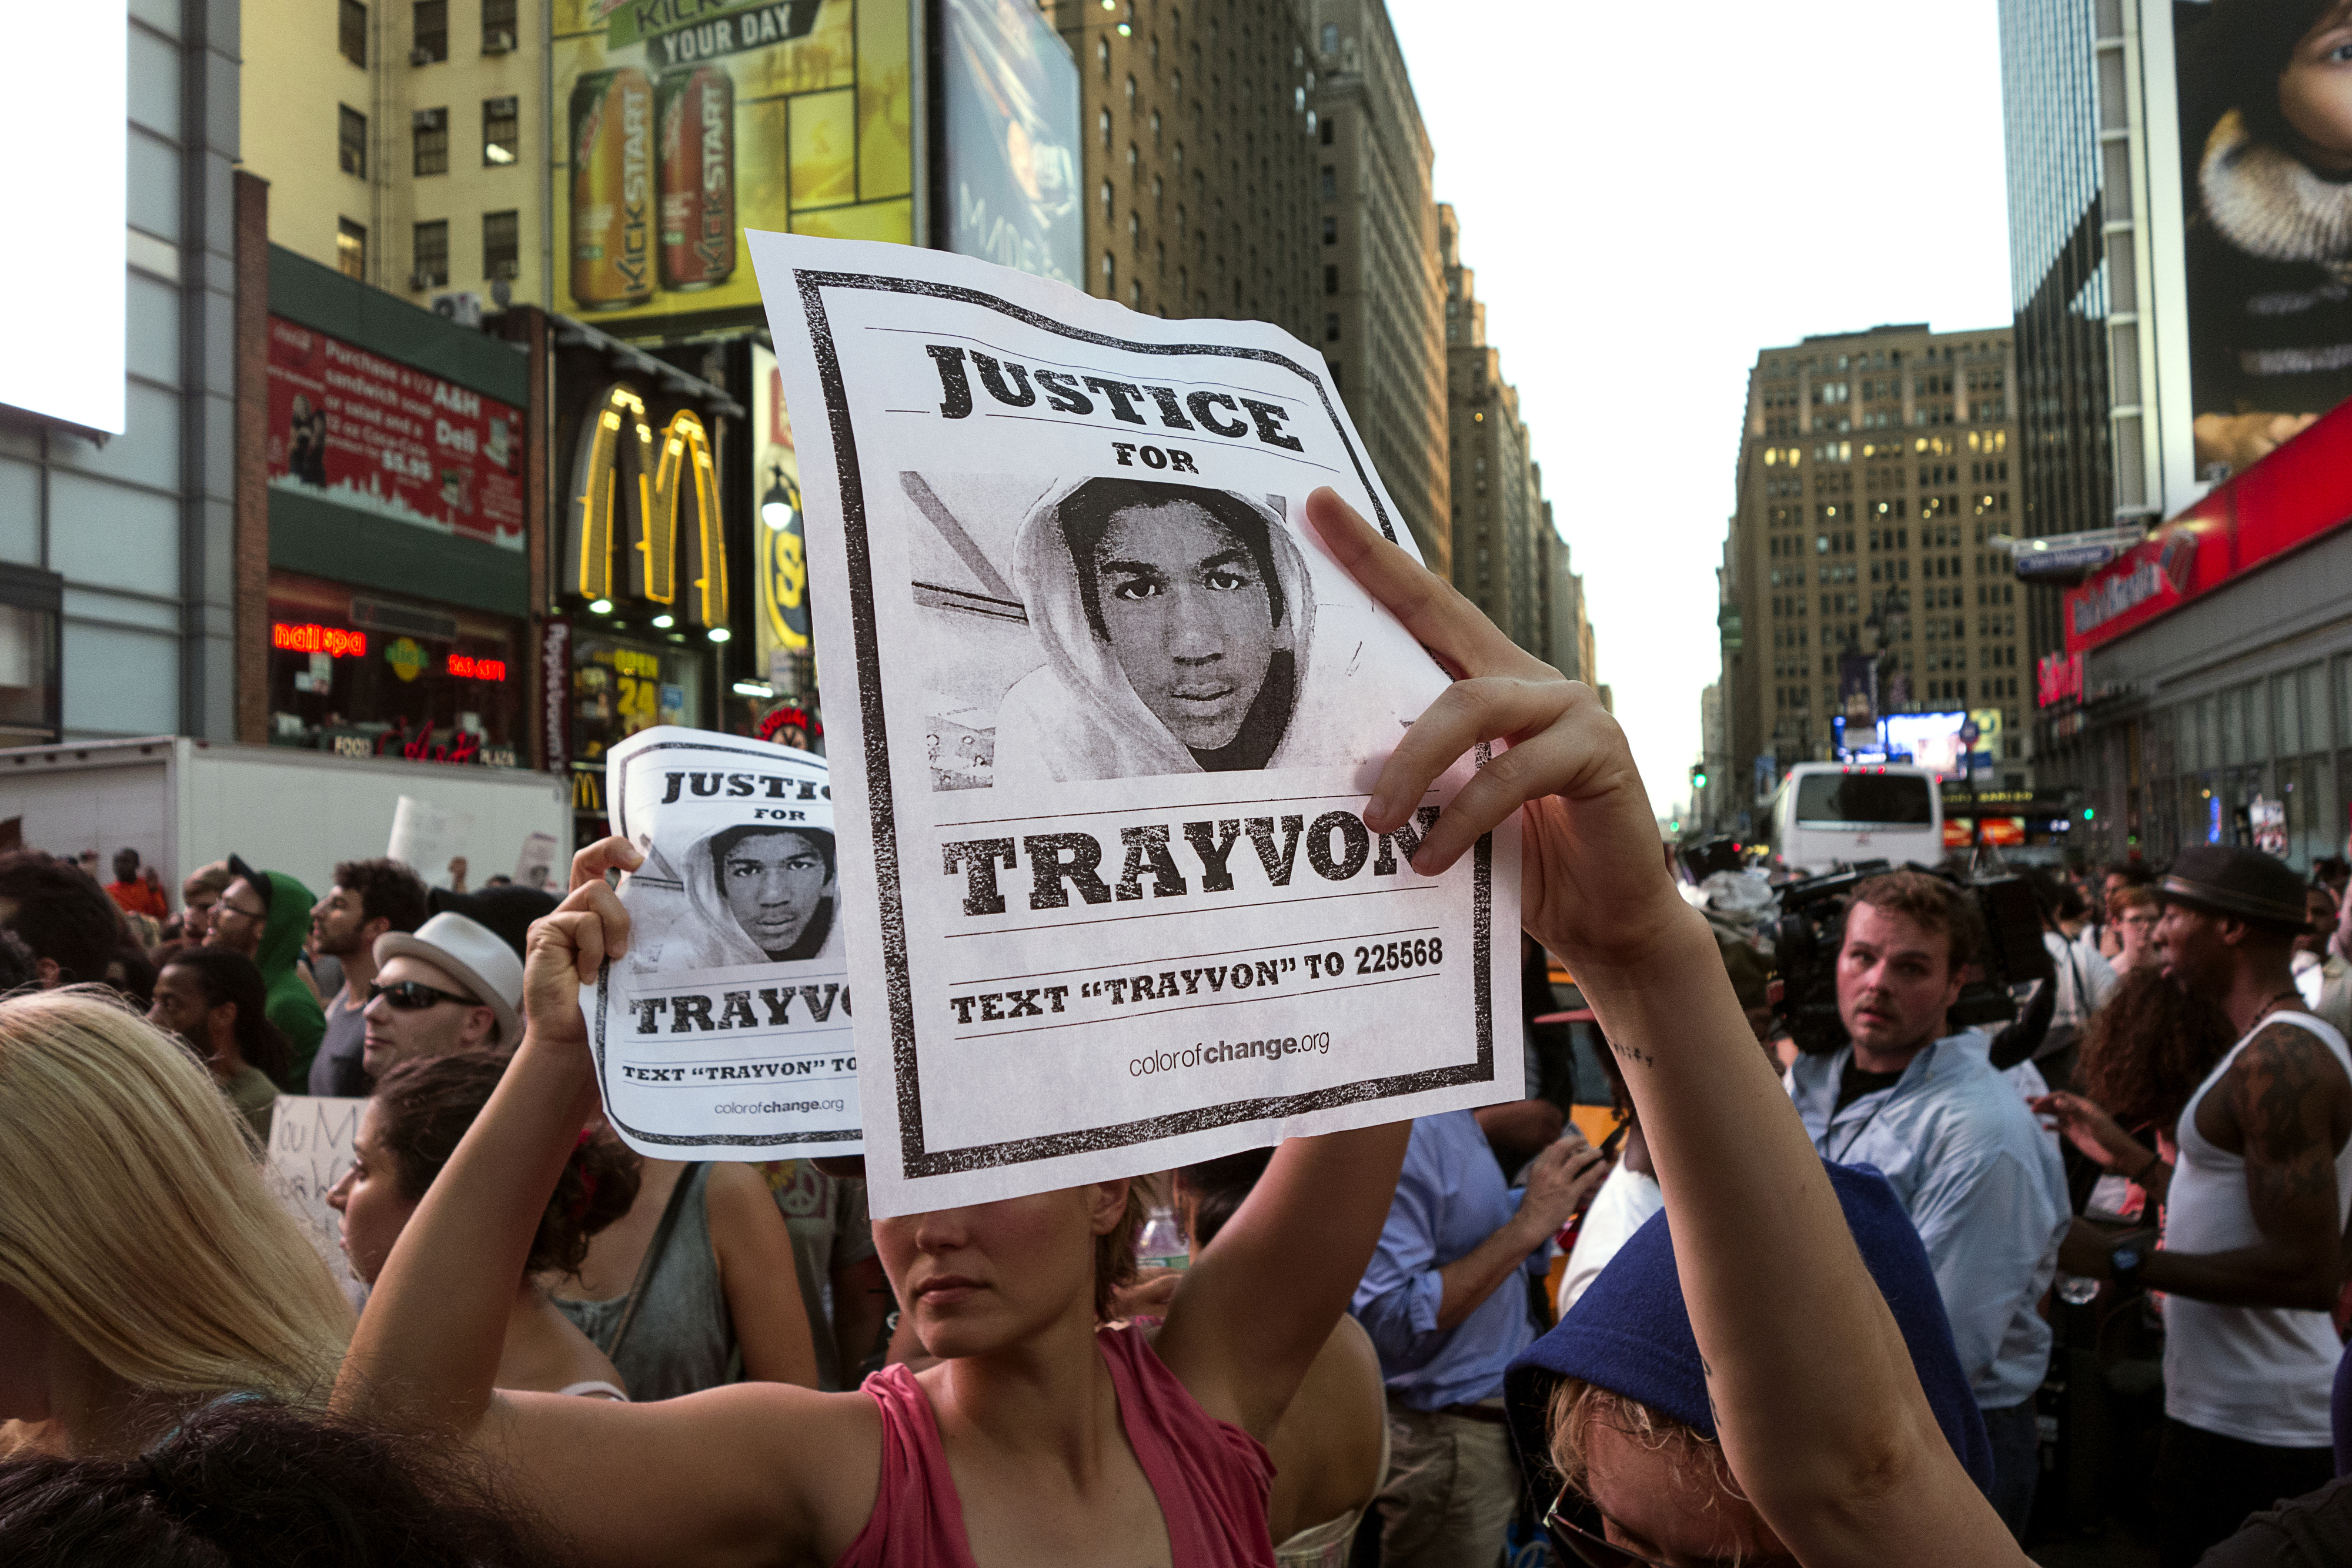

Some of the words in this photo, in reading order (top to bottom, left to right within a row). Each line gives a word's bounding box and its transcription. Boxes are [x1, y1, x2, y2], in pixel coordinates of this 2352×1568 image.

[662, 19, 734, 64] YOUR
[741, 3, 793, 46] DAY
[616, 86, 647, 295] KICKSTART
[693, 83, 726, 277] KICKSTART
[325, 368, 398, 405] sandwich
[433, 382, 480, 420] A&H
[926, 345, 1305, 453] JUSTICE
[435, 418, 479, 455] Deli
[1111, 442, 1199, 474] FOR
[275, 623, 323, 653] nail
[323, 627, 366, 658] spa
[334, 735, 373, 757] FOOD
[661, 772, 831, 804] JUSTI
[754, 808, 806, 821] FOR
[950, 985, 1069, 1025] TEXT
[1304, 951, 1345, 979] TO
[1354, 937, 1443, 976] 225568
[629, 983, 853, 1034] TRAYV
[623, 1065, 684, 1081] TEXT
[831, 1057, 857, 1072] TO
[1129, 1029, 1329, 1078] colorofchange.org
[714, 1098, 844, 1115] colorofchange.org
